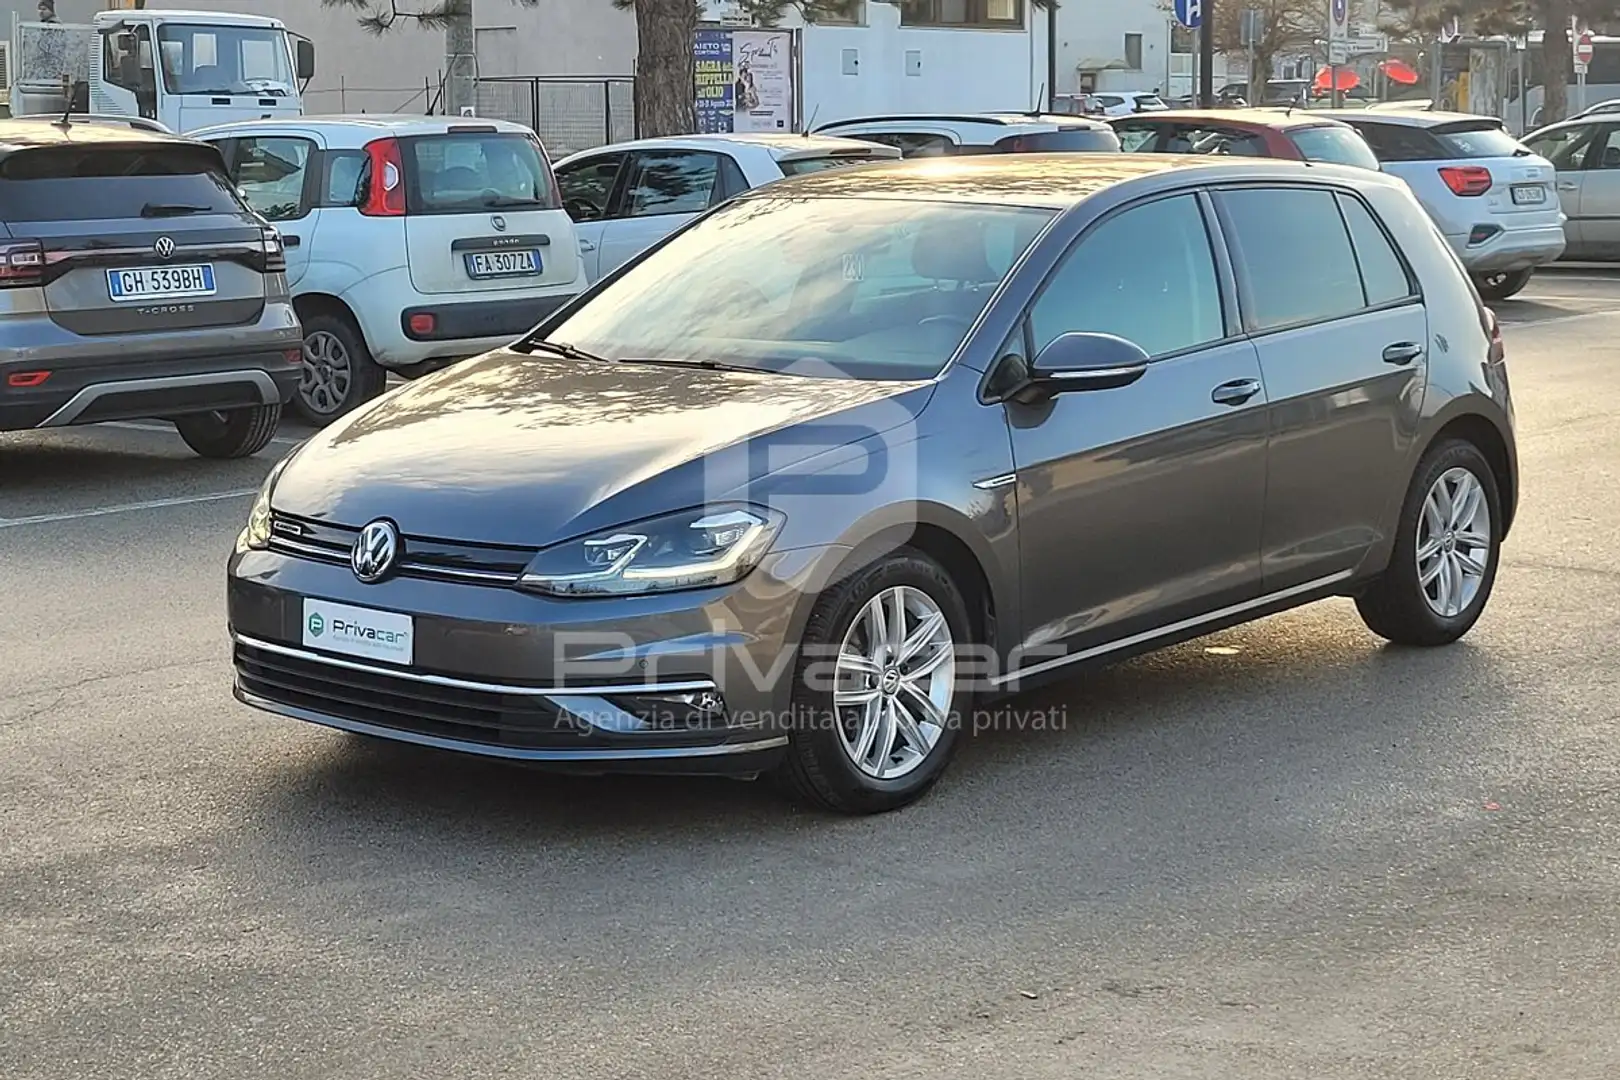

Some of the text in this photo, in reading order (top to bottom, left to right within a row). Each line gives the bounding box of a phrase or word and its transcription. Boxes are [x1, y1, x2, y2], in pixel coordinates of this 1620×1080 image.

[475, 253, 535, 273] FA 307ZA
[122, 272, 145, 292] GH
[151, 268, 203, 290] 539BH
[136, 304, 195, 315] T-CROSS
[333, 619, 405, 644] Privacar
